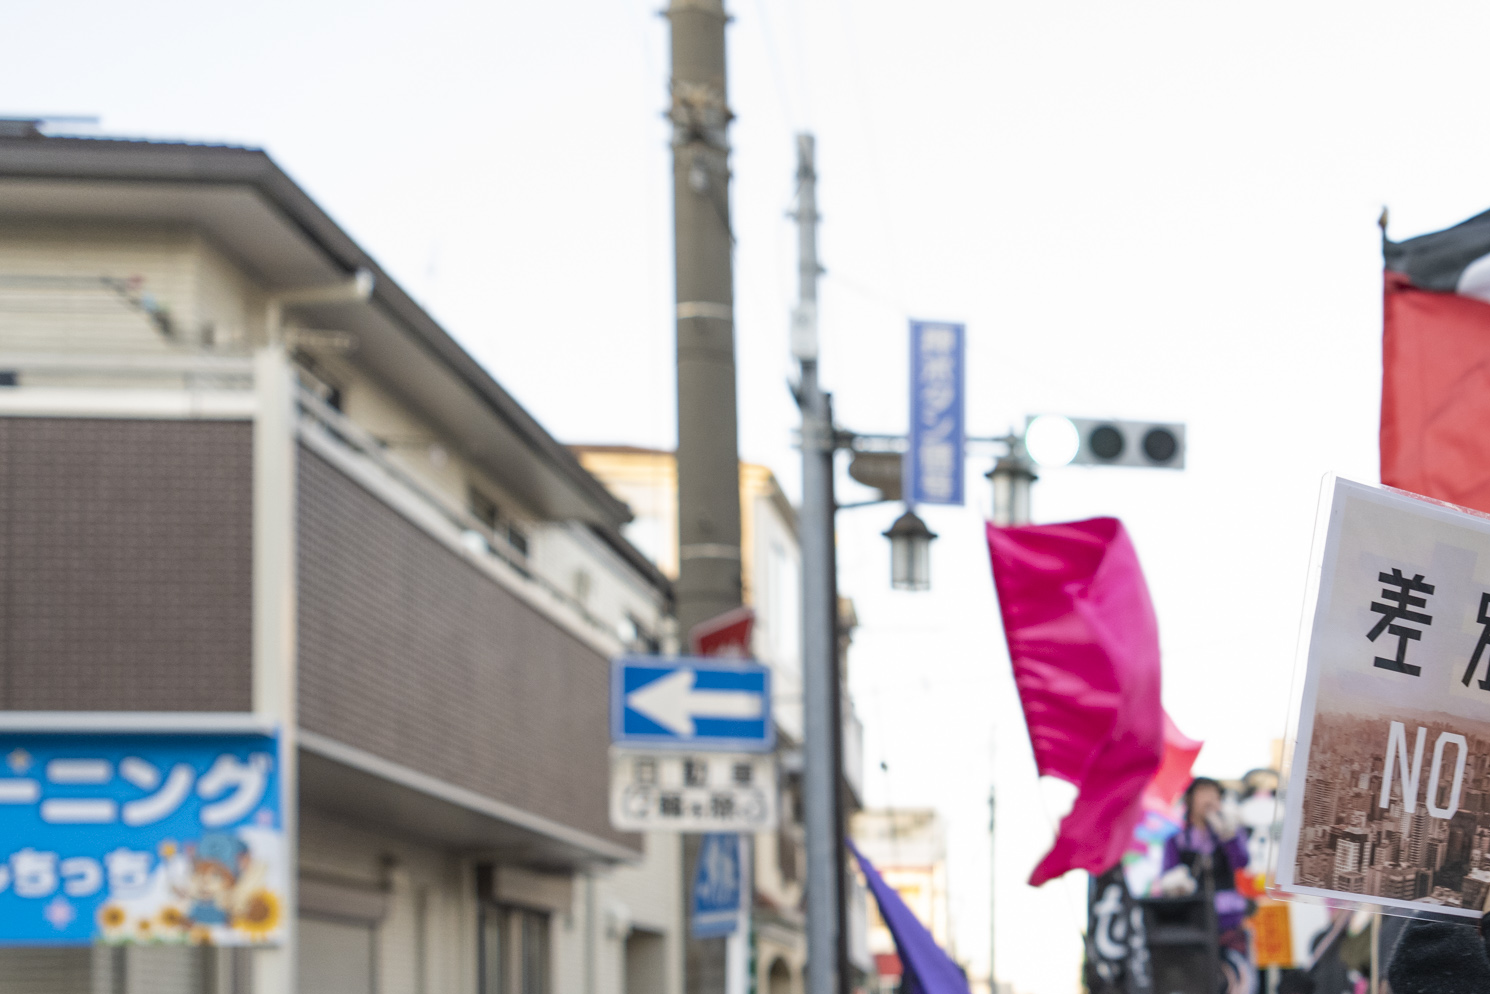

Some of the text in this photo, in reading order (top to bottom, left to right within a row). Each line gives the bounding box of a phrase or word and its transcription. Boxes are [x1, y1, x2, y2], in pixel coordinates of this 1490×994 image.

[1379, 720, 1469, 820] NO
[0, 847, 151, 898] ちっち
